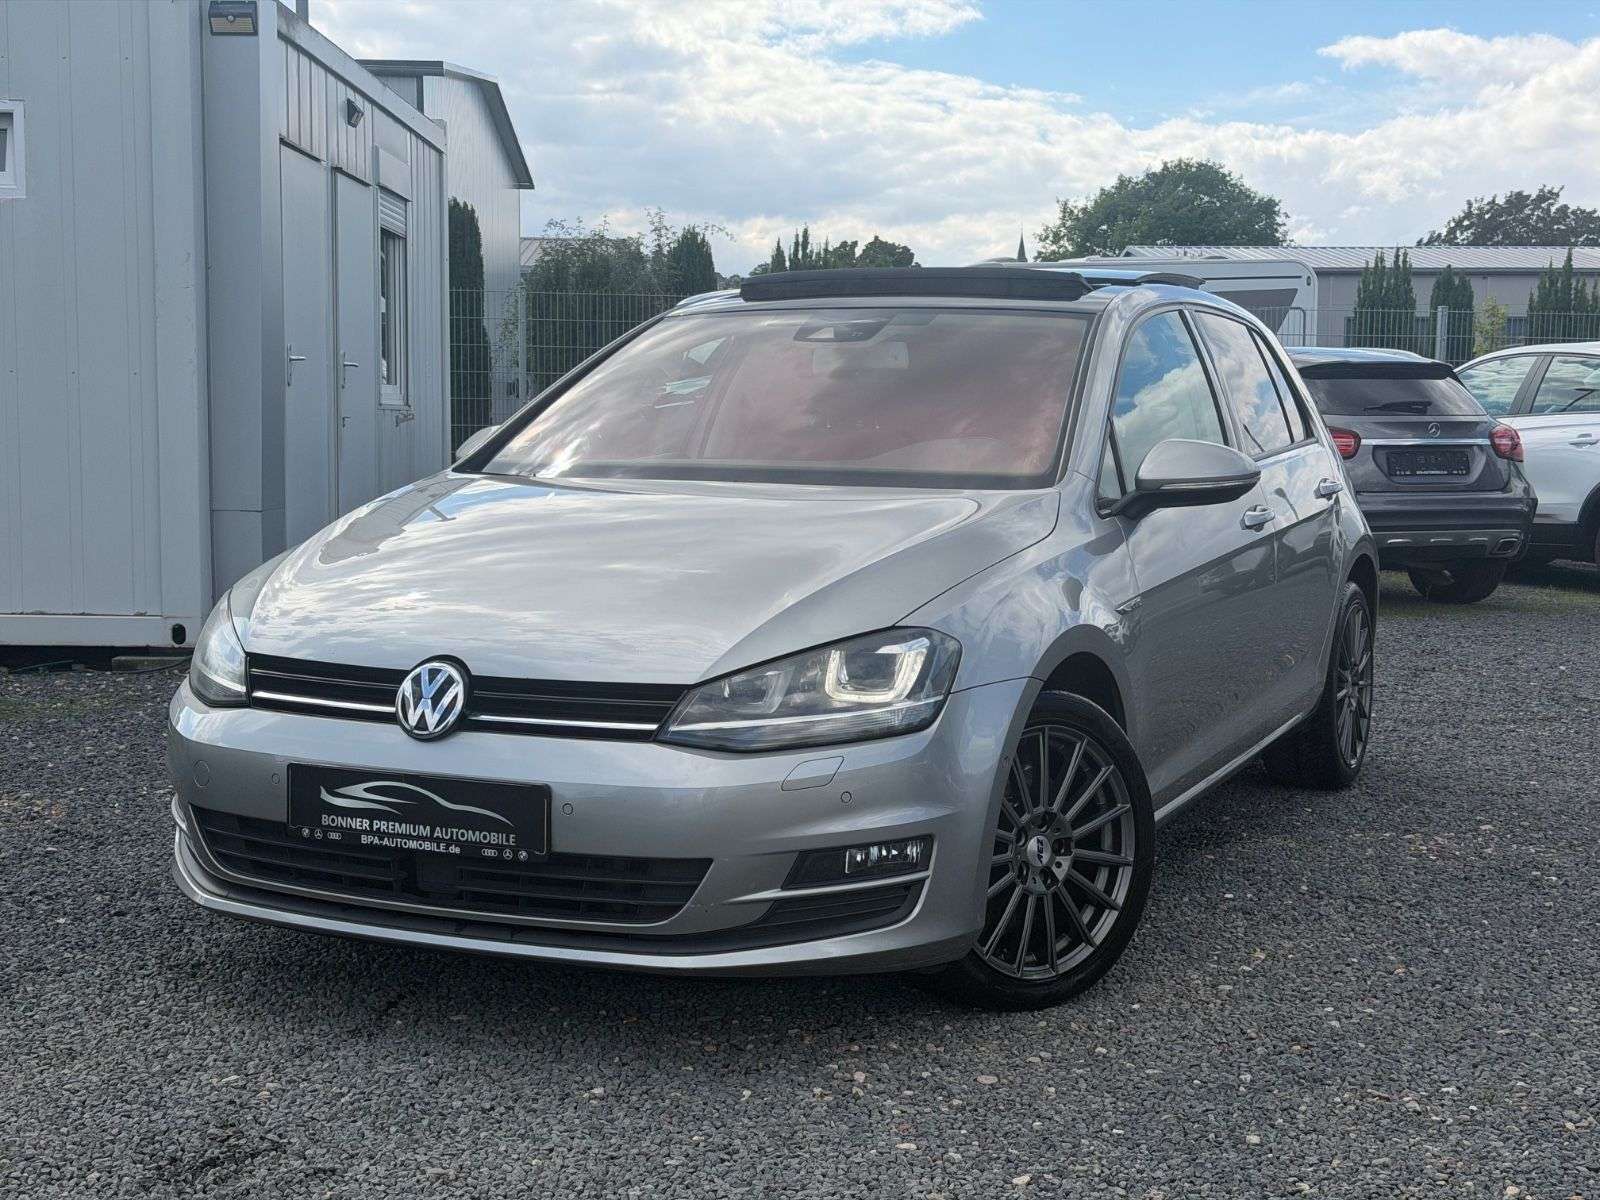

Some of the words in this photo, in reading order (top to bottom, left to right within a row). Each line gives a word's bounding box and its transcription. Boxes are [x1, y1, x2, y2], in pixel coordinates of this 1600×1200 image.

[402, 665, 461, 732] VW
[321, 814, 371, 831] BONNER
[372, 820, 431, 837] PREMIUM
[433, 826, 517, 846] AUTOMOBILE
[360, 834, 461, 854] BPA-AUTOMOBILE.de
